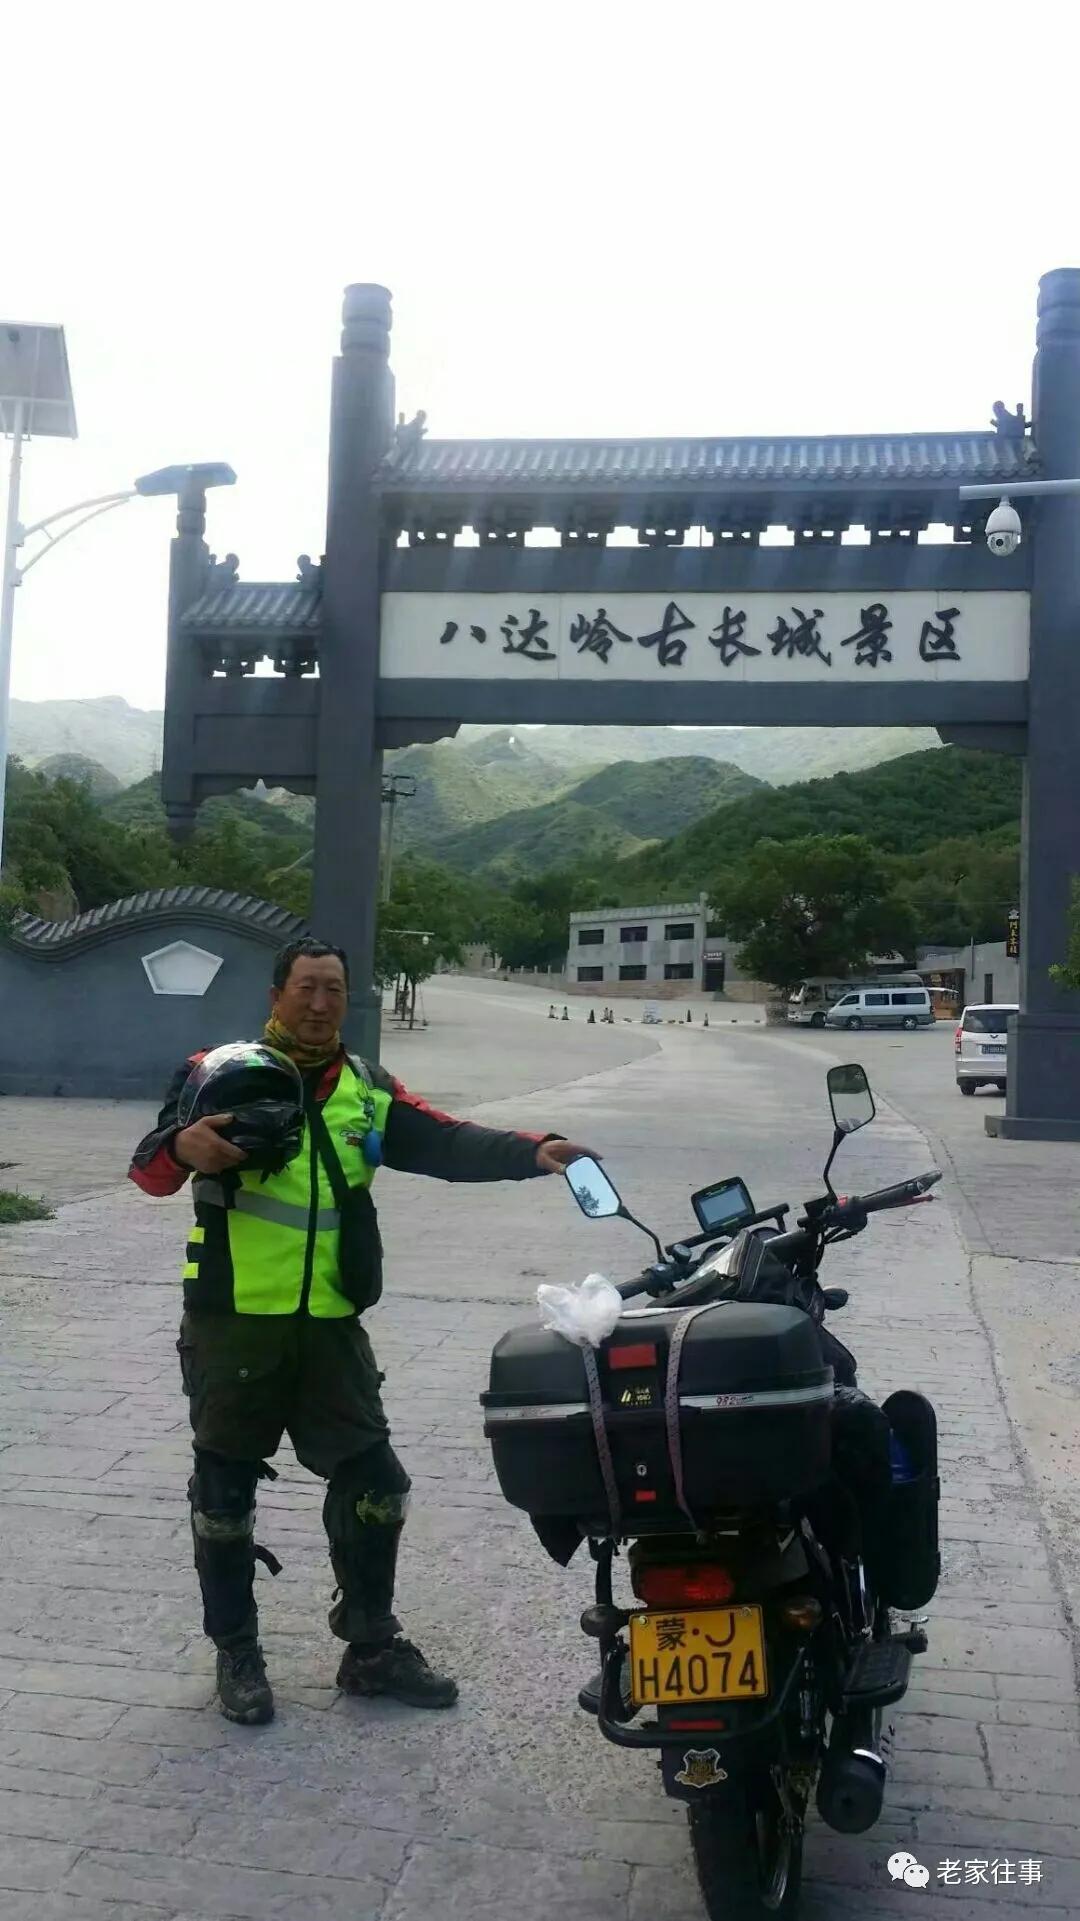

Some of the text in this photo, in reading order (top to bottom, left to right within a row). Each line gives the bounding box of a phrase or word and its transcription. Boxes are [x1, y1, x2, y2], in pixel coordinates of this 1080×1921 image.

[441, 601, 962, 668] 八达岭古长城景区
[639, 1650, 759, 1699] H4074
